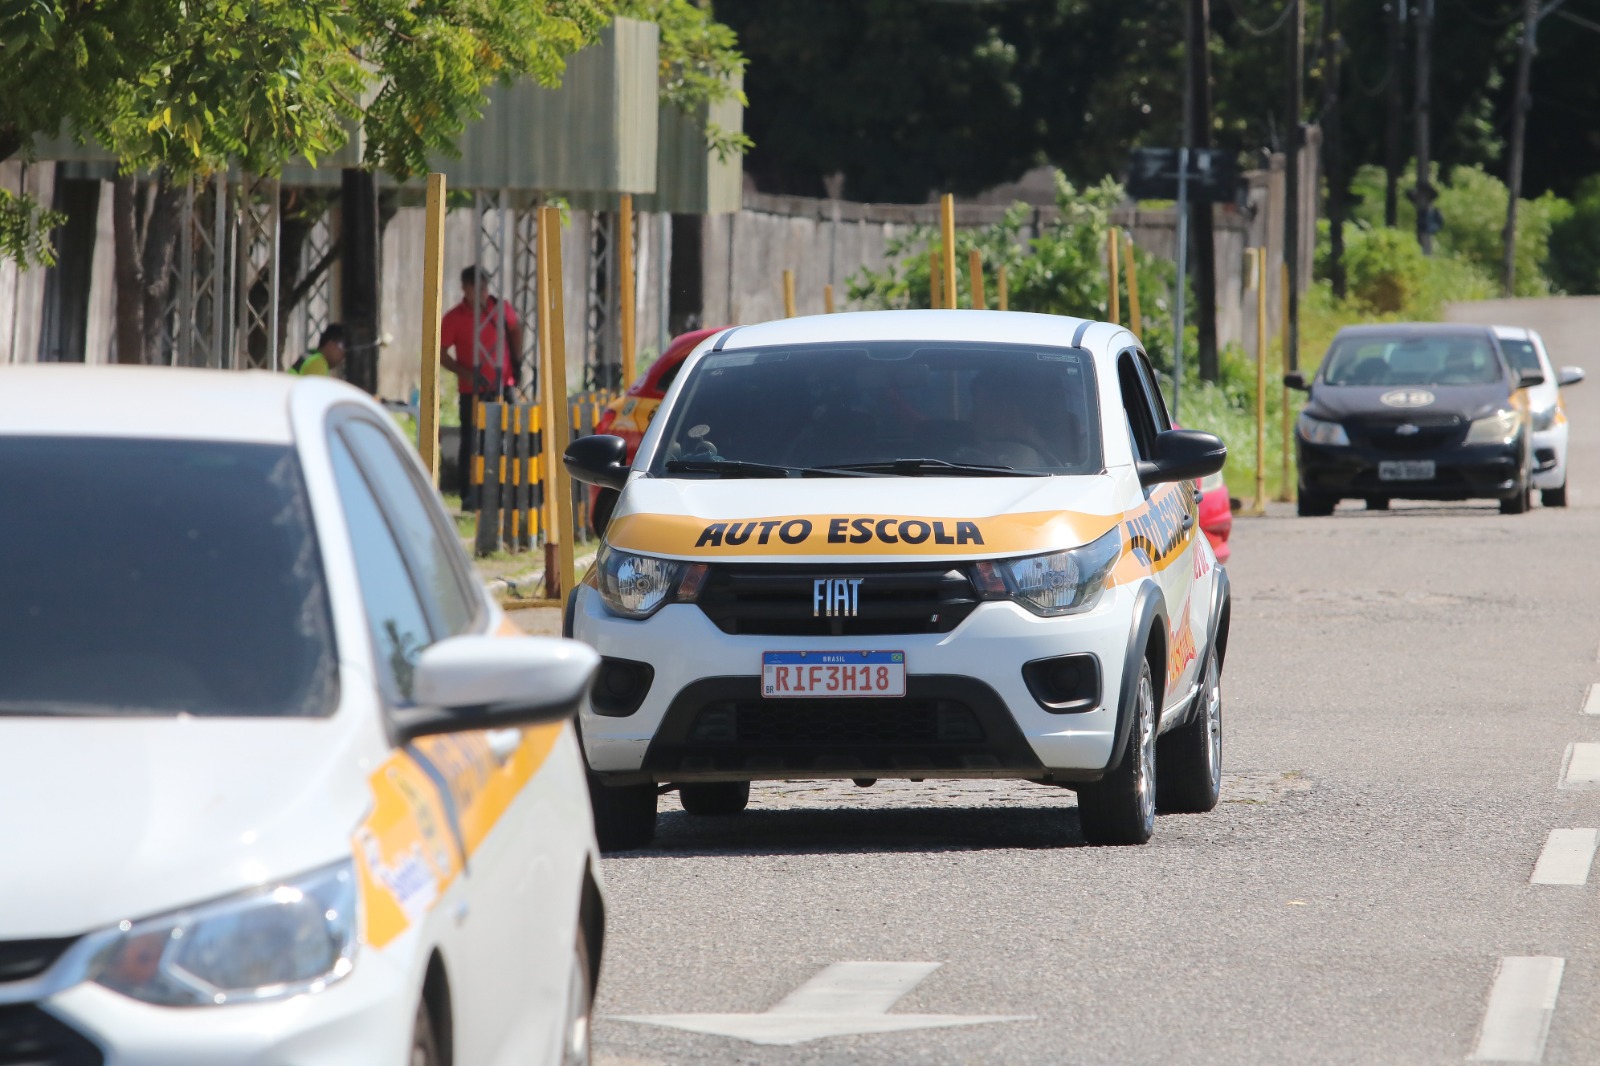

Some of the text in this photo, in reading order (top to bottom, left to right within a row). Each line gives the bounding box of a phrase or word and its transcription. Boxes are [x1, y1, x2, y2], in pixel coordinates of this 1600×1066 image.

[695, 518, 985, 548] AUTO ESCOLA
[813, 578, 864, 617] FIAT
[765, 685, 774, 694] BR
[775, 666, 889, 691] RIF3H18
